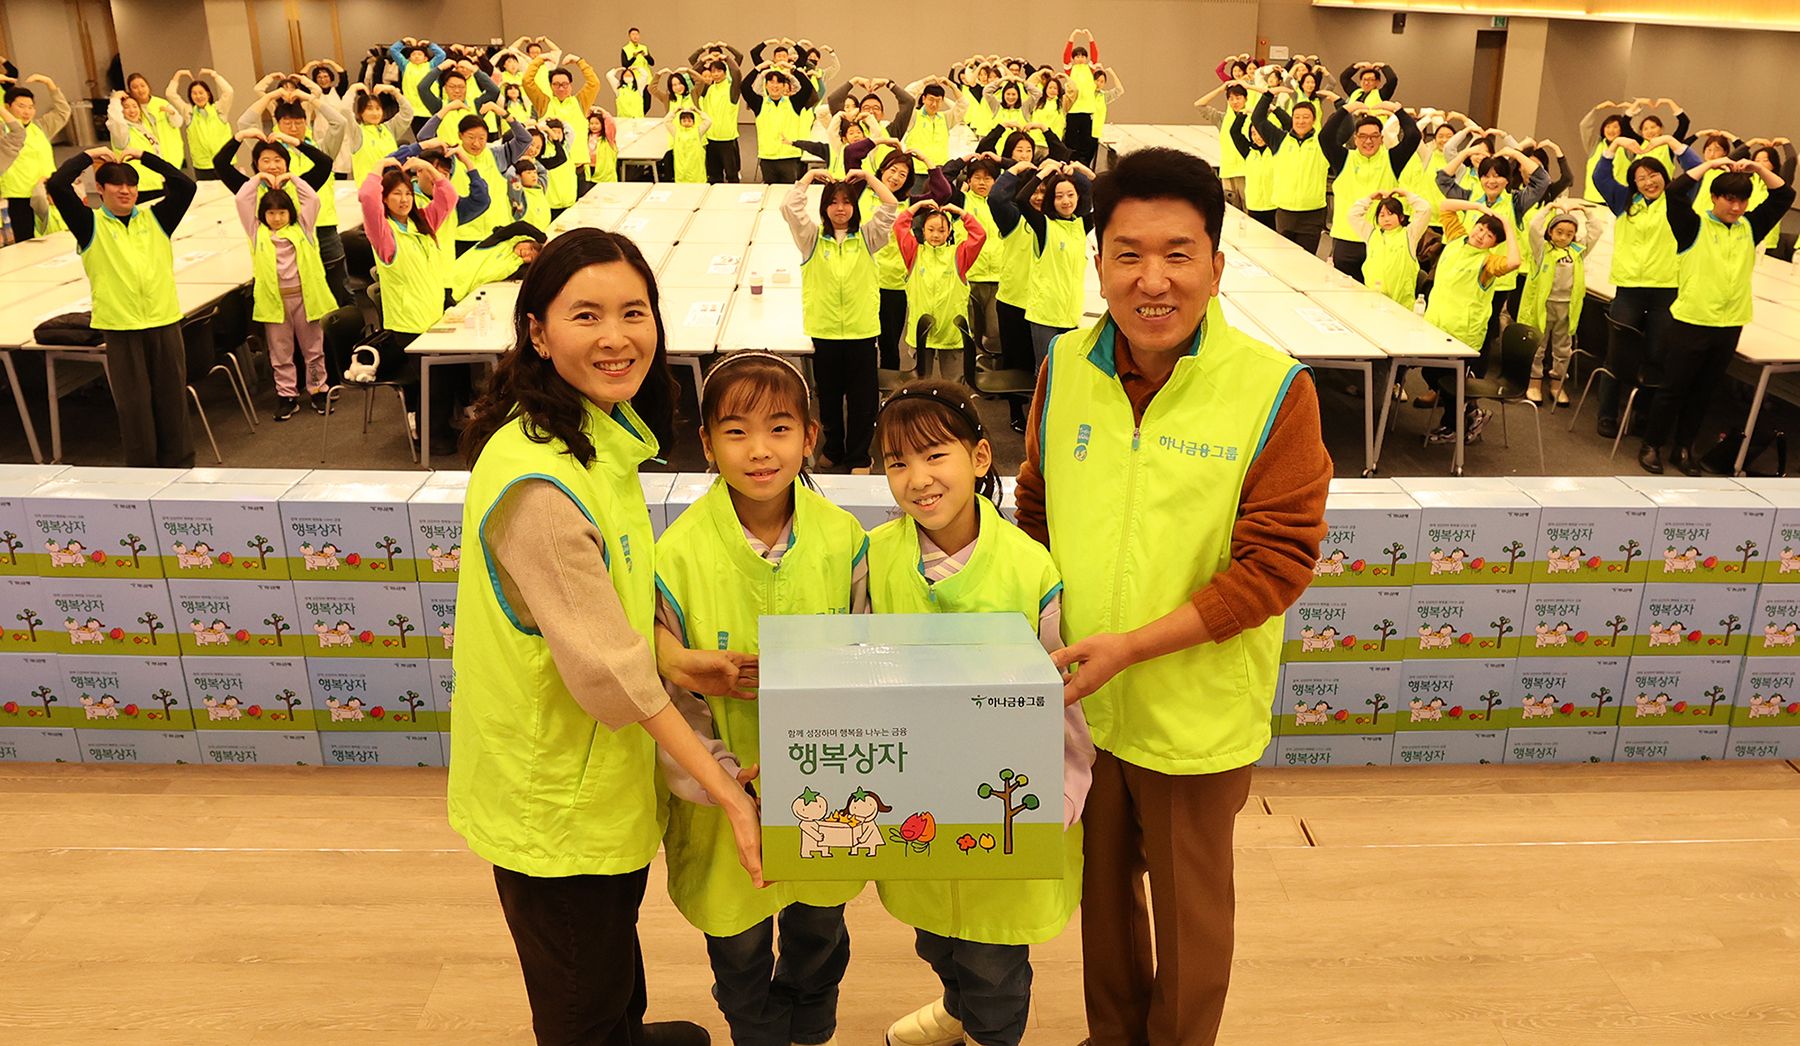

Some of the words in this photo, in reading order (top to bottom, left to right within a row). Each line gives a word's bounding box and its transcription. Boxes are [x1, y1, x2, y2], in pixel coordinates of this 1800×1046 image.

[1159, 435, 1238, 461] 하나금융그룹
[36, 520, 85, 534] 행복상자
[164, 522, 213, 536] 행복상자
[292, 523, 341, 537] 행복상자
[1429, 529, 1475, 542] 행복상자
[1547, 528, 1592, 541] 행복상자
[1664, 528, 1709, 541] 행복상자
[55, 598, 104, 612] 행복상자
[182, 600, 230, 614] 행복상자
[306, 601, 355, 615] 행복상자
[1535, 604, 1579, 616] 행복상자
[1650, 604, 1693, 616] 행복상자
[1765, 605, 1800, 617] 행복상
[1299, 608, 1345, 621] 행복상자
[1418, 606, 1463, 618] 행복상자
[71, 675, 118, 689] 행복상자
[195, 678, 242, 690] 행복상자
[319, 679, 366, 691] 행복상자
[1408, 680, 1453, 692] 행복상자
[1522, 676, 1565, 689] 행복상자
[1636, 676, 1679, 688] 행복상자
[1751, 678, 1793, 689] 행복상자
[1292, 683, 1337, 696] 행복상자
[988, 695, 1045, 709] 하나금융그룹
[787, 729, 804, 738] 함께
[806, 729, 838, 738] 성장하며
[840, 728, 863, 738] 행복을
[865, 728, 890, 737] 나누는
[892, 727, 908, 737] 금융
[90, 749, 136, 760] 행복상자
[210, 749, 256, 762] 행복상자
[332, 750, 378, 762] 행복상자
[1401, 749, 1445, 762] 행복상자
[1514, 748, 1556, 759] 행복상자
[1625, 746, 1667, 757] 행복상자
[1735, 746, 1777, 757] 행복상자
[788, 742, 908, 775] 행복상자
[1286, 753, 1329, 765] 행복상자
